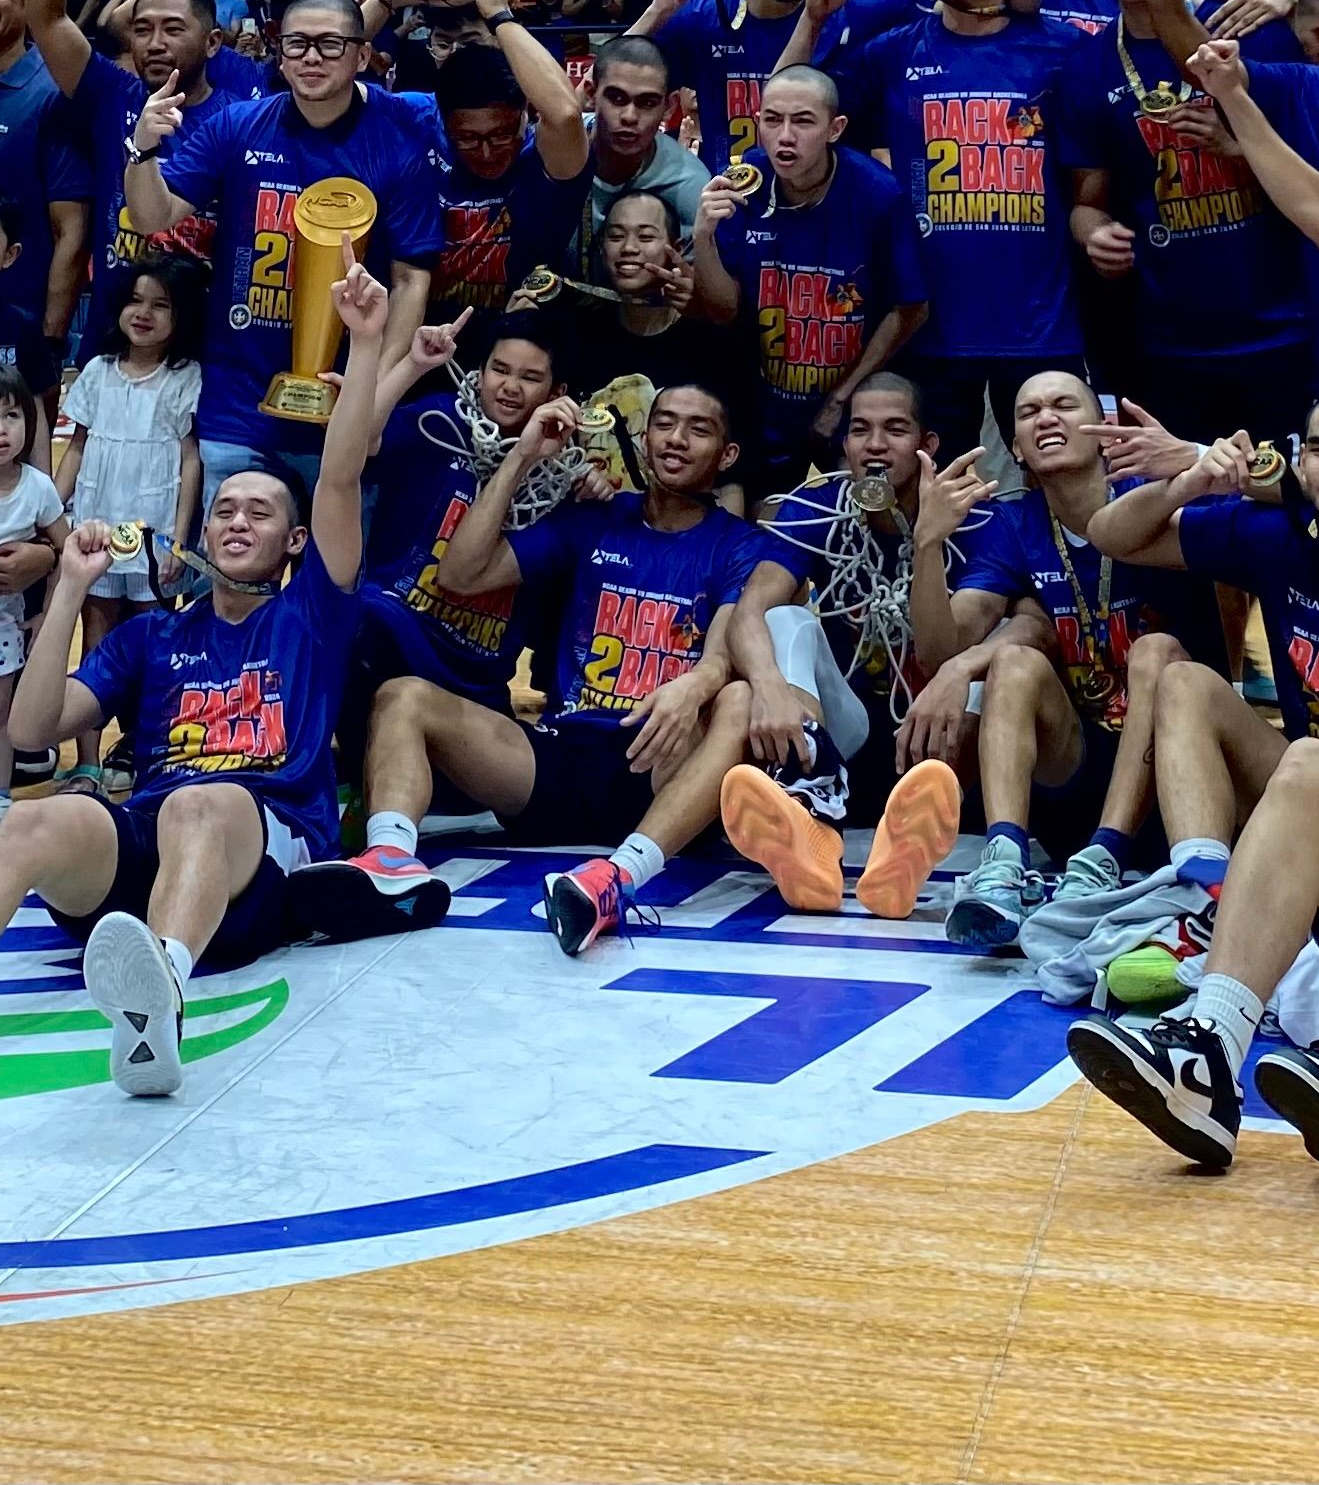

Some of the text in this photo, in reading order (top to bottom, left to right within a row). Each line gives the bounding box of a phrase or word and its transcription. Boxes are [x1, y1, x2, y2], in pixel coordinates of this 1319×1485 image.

[923, 99, 1012, 146] BACK
[258, 151, 284, 164] TELA
[926, 139, 1045, 195] 2 BACK
[1151, 144, 1181, 196] 2
[927, 193, 1045, 224] CHAMPIONS
[252, 232, 288, 287] 2
[759, 268, 831, 321] BACK
[759, 307, 864, 366] 2 BACK
[594, 591, 679, 653] BACK
[585, 634, 623, 693] 2
